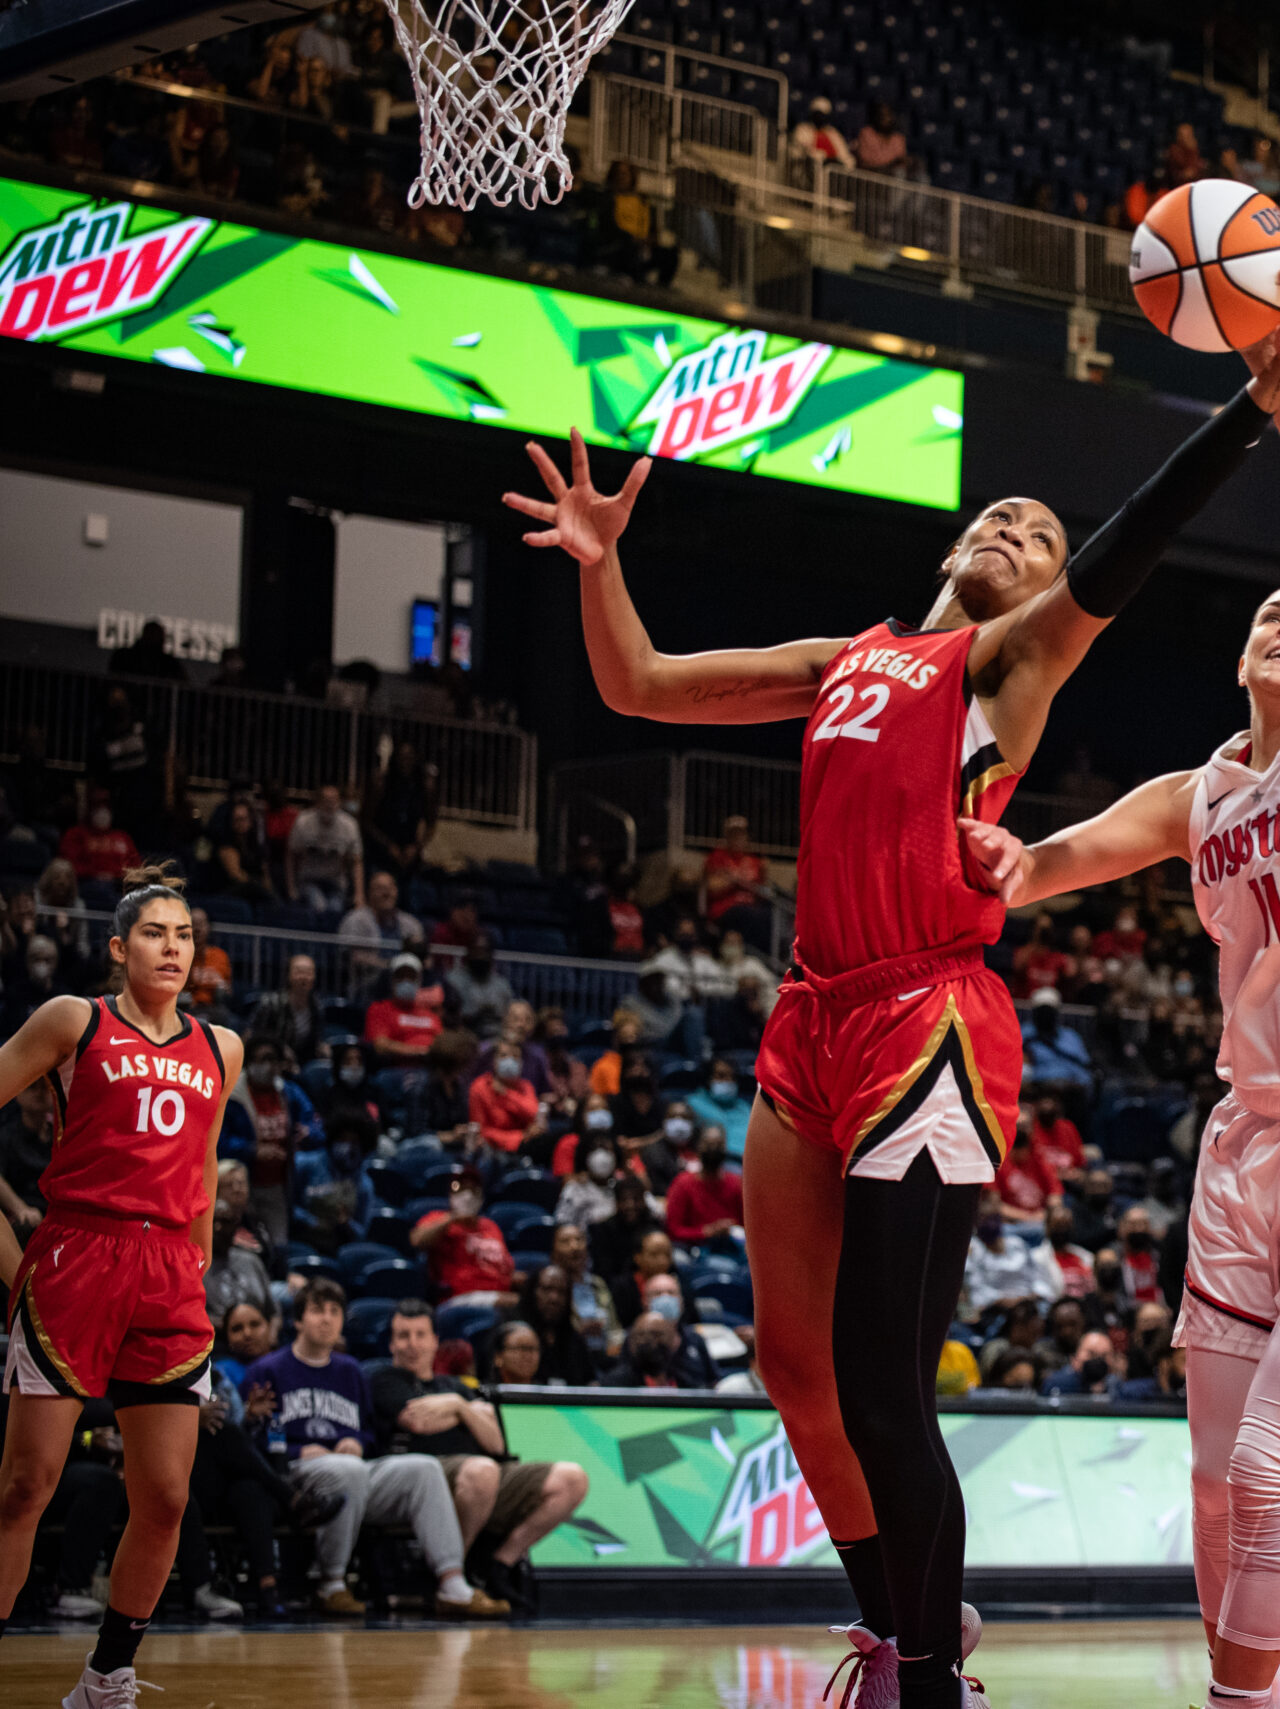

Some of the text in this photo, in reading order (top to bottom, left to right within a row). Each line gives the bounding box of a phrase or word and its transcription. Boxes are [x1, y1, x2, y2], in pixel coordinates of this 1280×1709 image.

[819, 651, 865, 694] LAS
[861, 648, 939, 690] VEGAS
[812, 683, 891, 743] 22
[100, 1053, 215, 1100] LAS VEGAS
[136, 1086, 186, 1137] 10
